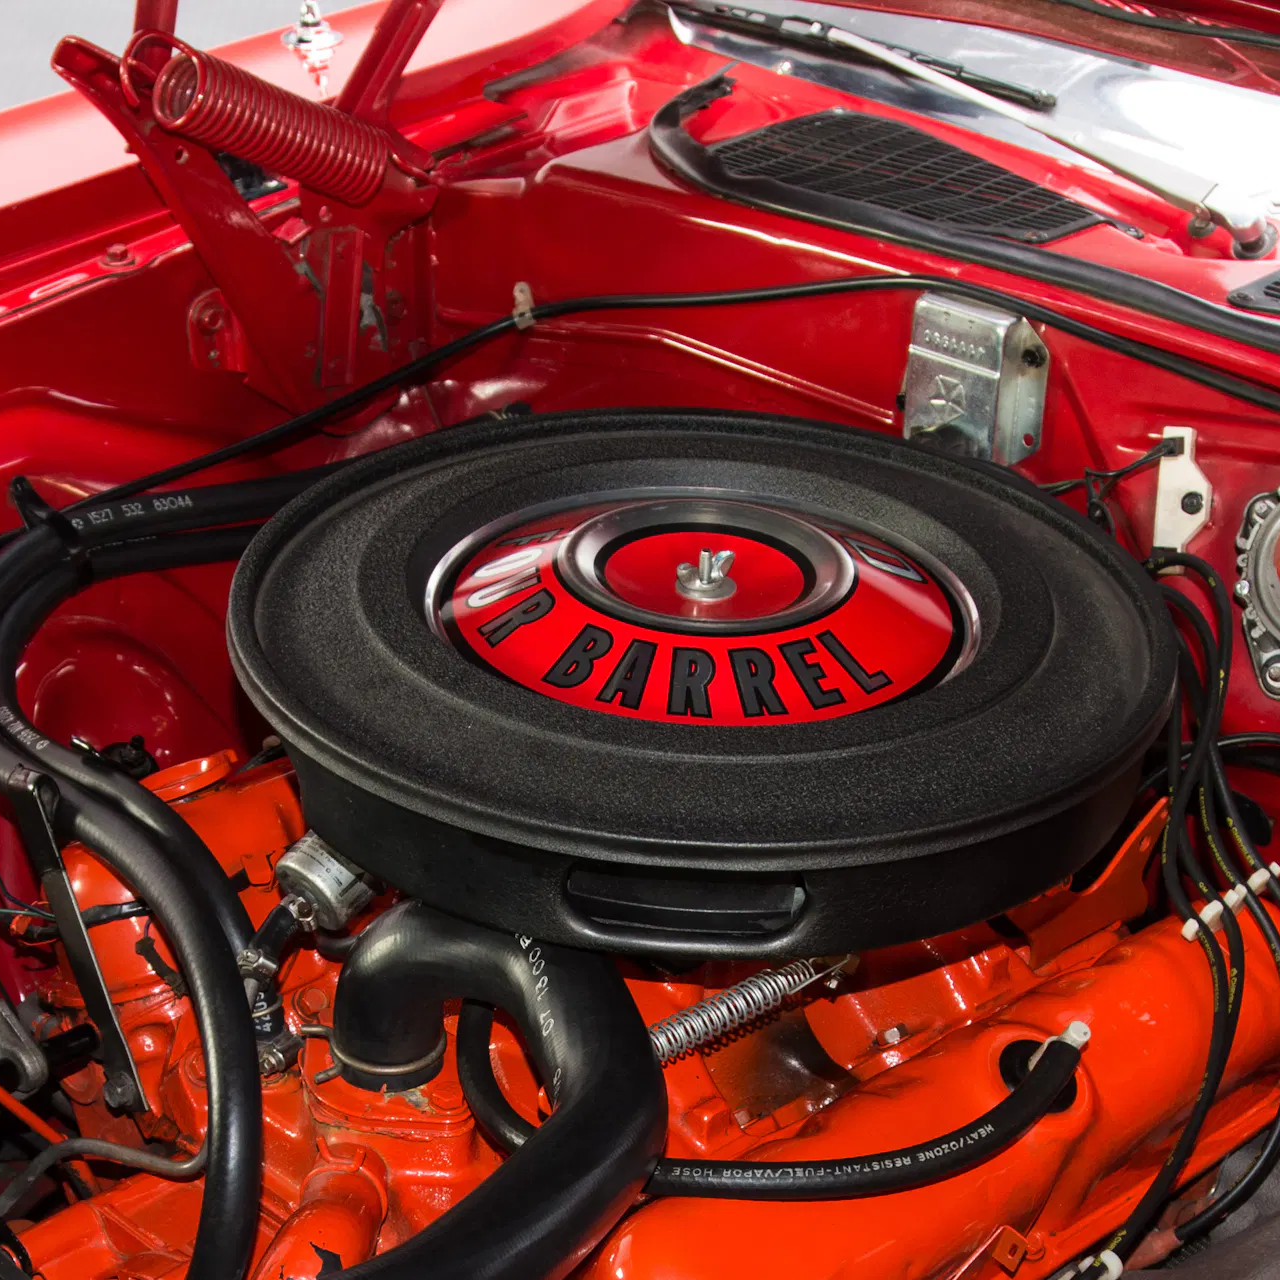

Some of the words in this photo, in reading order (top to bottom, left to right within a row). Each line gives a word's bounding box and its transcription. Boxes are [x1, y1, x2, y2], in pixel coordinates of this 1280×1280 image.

[122, 502, 143, 516] 532
[465, 526, 565, 649] FOUR
[542, 623, 893, 723] BARREL
[918, 1123, 995, 1163] HEAT/OZONE
[671, 1166, 714, 1177] HOSE
